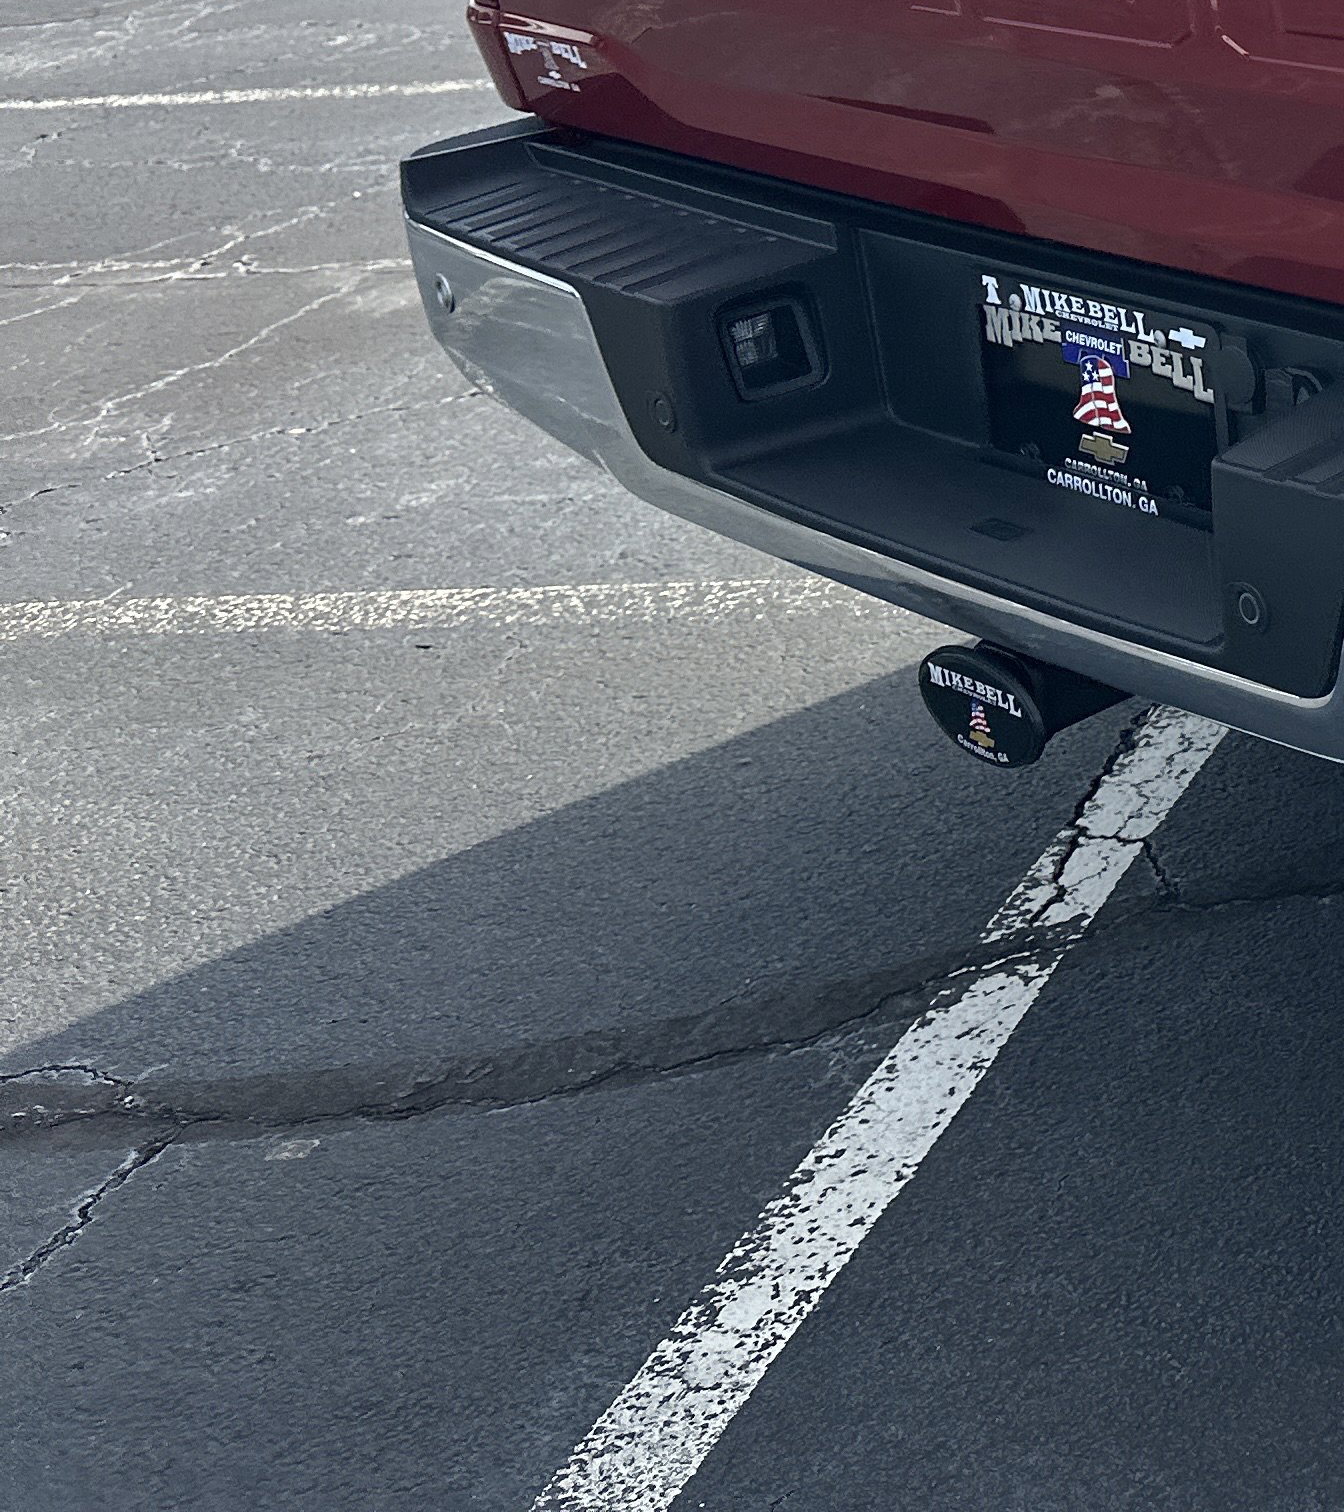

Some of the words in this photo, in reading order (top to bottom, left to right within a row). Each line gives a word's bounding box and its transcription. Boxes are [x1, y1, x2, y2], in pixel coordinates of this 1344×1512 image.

[982, 304, 1063, 348] MIKE
[1019, 283, 1086, 316] MIKE
[1087, 299, 1156, 344] BELL
[1055, 309, 1121, 332] CHEVROLET
[1065, 329, 1123, 355] CHEVROLET
[1127, 339, 1214, 403] BELL
[1133, 478, 1148, 491] GA
[1138, 496, 1159, 516] GA
[927, 661, 975, 691] MIKE
[974, 680, 1022, 718] BELL
